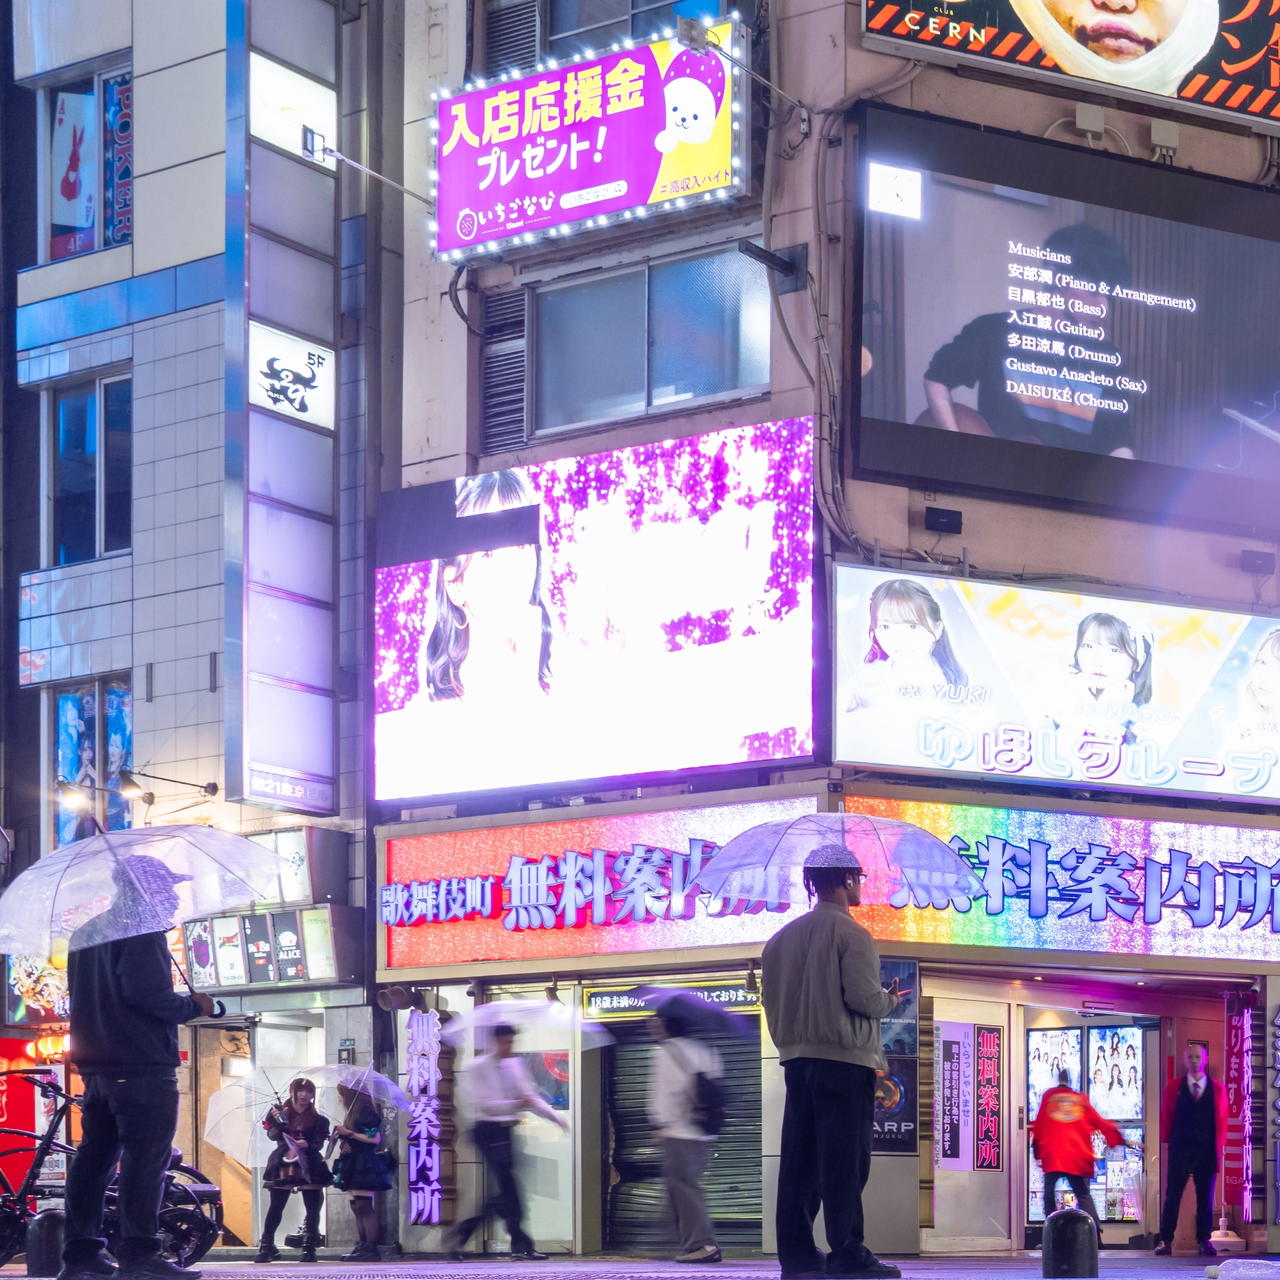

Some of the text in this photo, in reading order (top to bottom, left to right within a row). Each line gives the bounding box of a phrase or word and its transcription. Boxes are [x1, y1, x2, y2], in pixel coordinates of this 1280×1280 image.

[933, 6, 955, 16] CLUB
[903, 13, 987, 45] CERN
[442, 58, 646, 157] 入店応援金
[113, 84, 133, 243] POKER
[477, 126, 608, 191] プレゼント!
[478, 191, 556, 226] いちごなび
[1008, 241, 1072, 265] Musicians
[1055, 273, 1097, 293] (Piano
[1099, 282, 1110, 295] &
[1112, 285, 1197, 313] Arrangement)
[1068, 299, 1108, 318] (Bass)
[1054, 319, 1105, 341] (Guitar)
[307, 352, 326, 368] 5F
[1068, 345, 1122, 367] (Drums)
[1006, 357, 1148, 394] Gustavo Anacleto (Sax)
[1006, 380, 1129, 414] DAISUKÉ (Chorus)
[916, 717, 1278, 794] ゆほしグループ
[380, 876, 495, 928] 歌舞伎町
[279, 950, 302, 960] ALICE
[978, 1029, 1001, 1169] 無料案内所
[406, 1008, 442, 1228] 無料案内所
[873, 1121, 915, 1133] ARP
